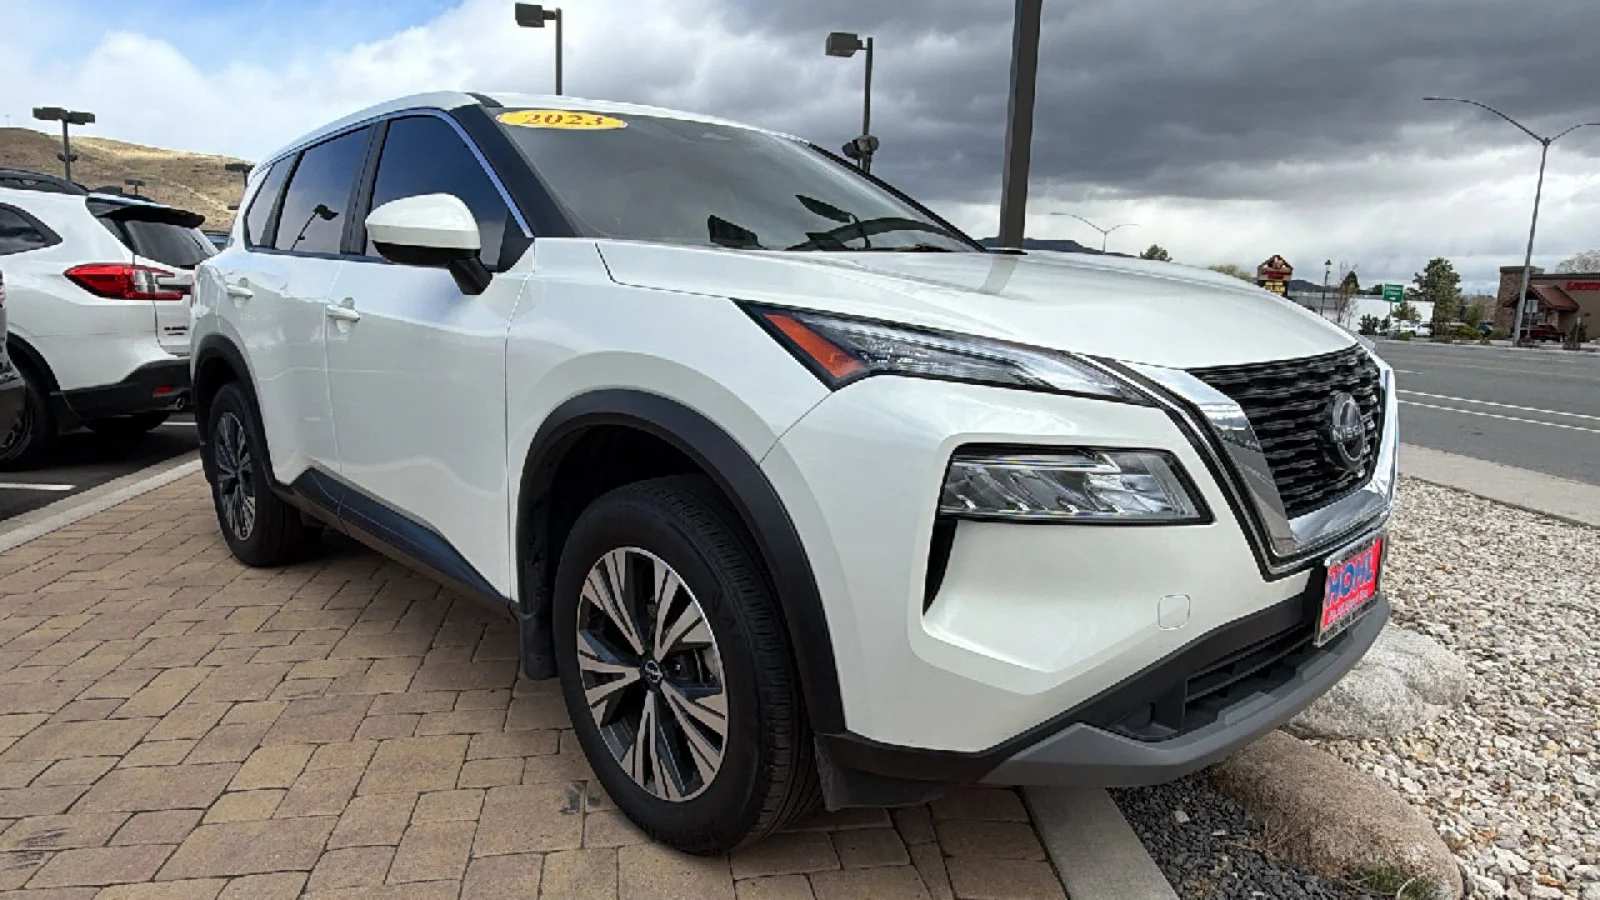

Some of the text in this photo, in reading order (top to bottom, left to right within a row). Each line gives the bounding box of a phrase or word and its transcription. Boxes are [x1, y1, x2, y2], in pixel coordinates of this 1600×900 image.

[522, 114, 603, 126] 2023
[1332, 425, 1363, 440] NISS
[1325, 551, 1373, 607] HOHL
